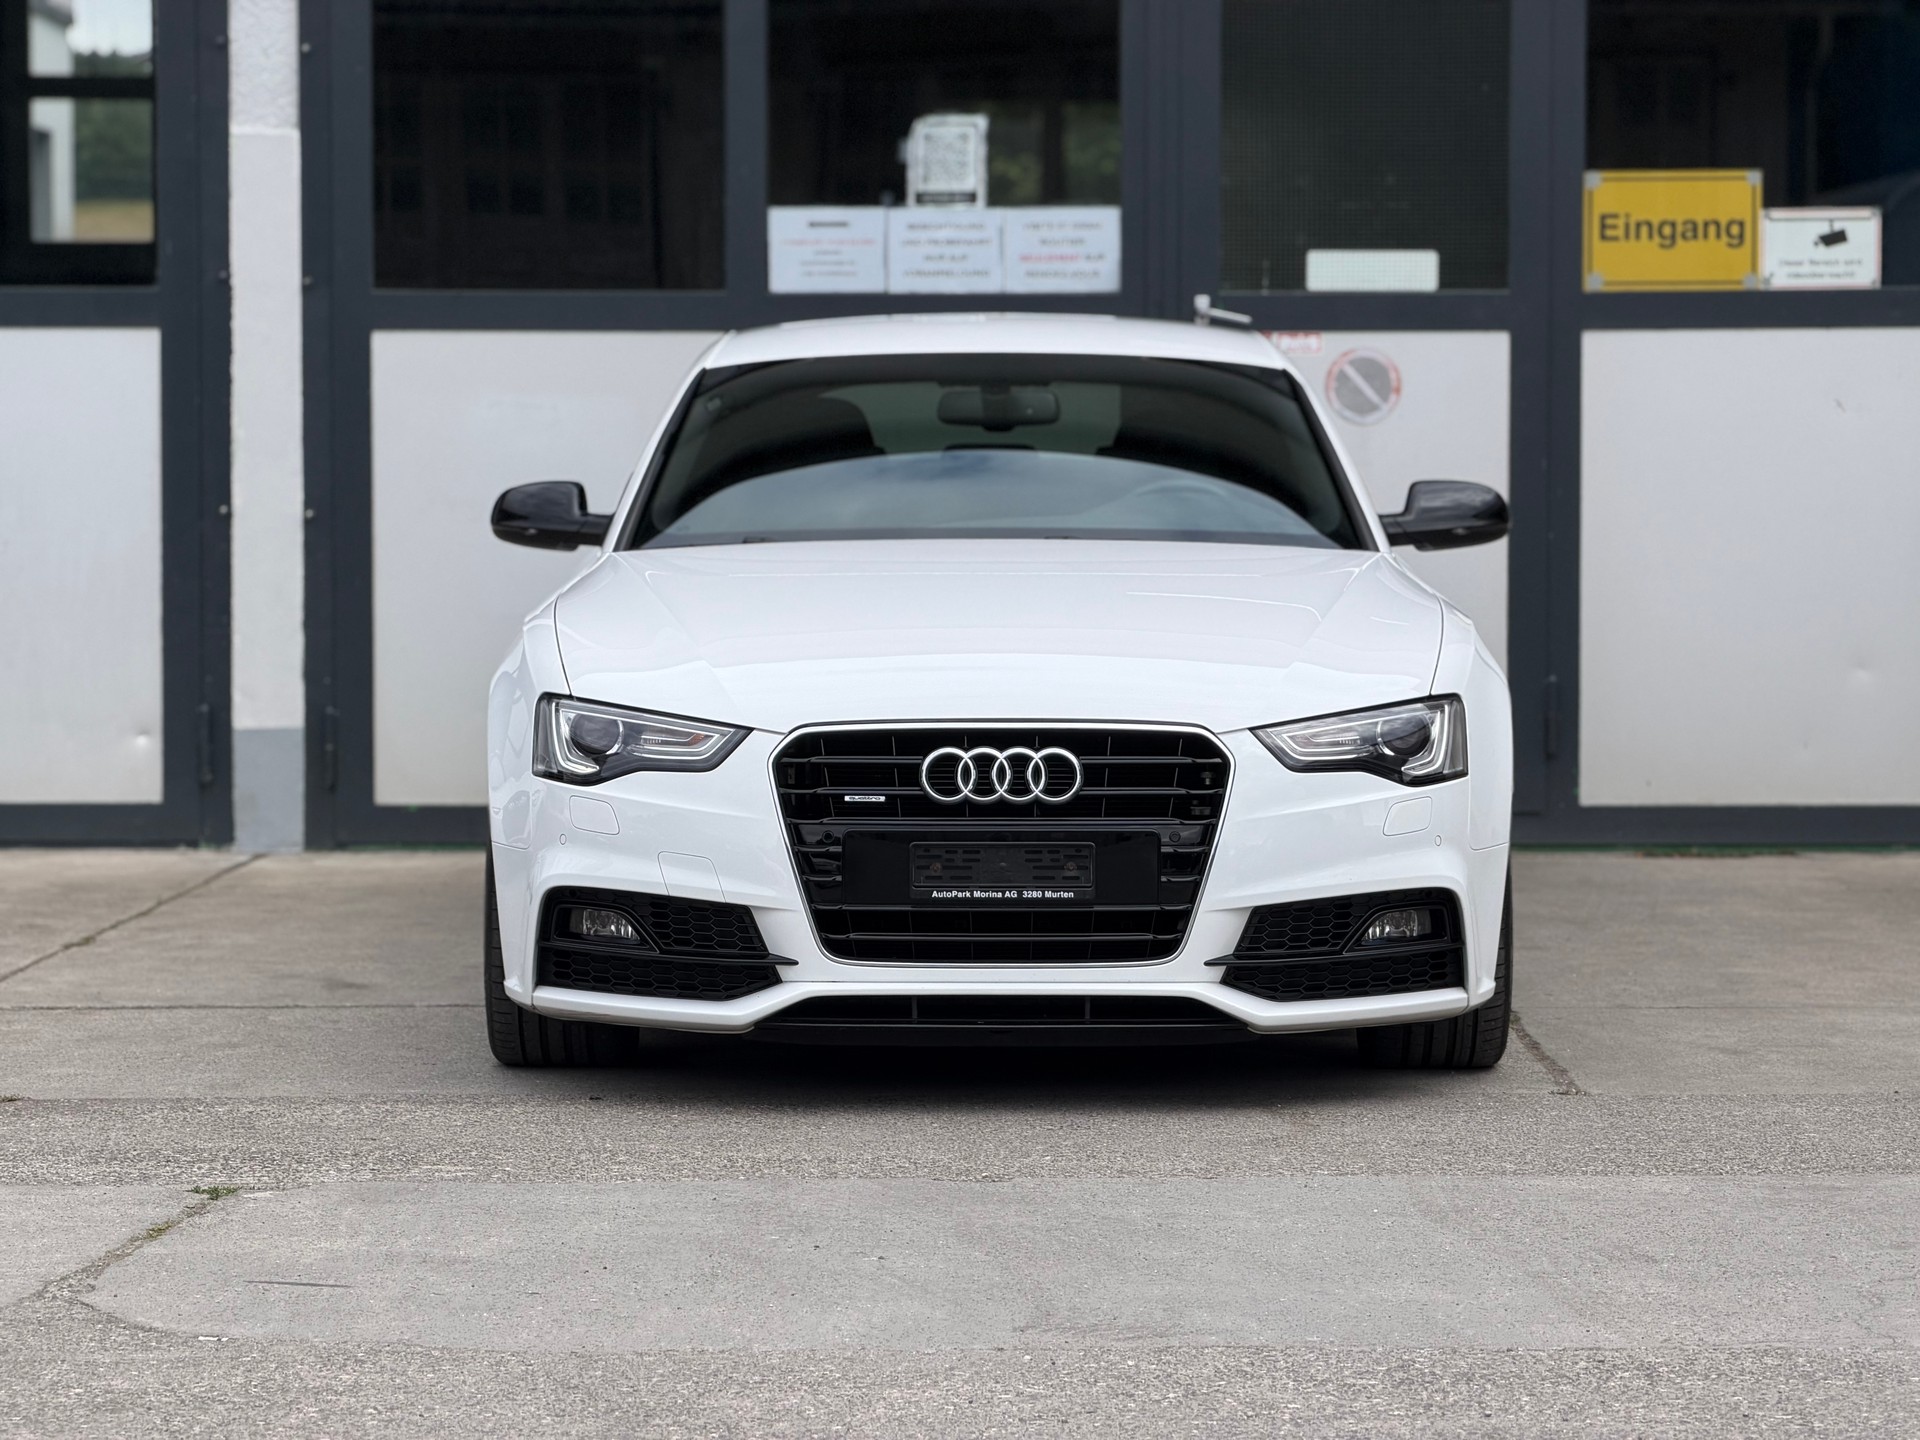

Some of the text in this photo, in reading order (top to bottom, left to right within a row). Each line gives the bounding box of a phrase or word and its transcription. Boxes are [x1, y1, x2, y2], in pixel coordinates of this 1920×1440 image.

[1599, 213, 1746, 250] Eingang
[931, 890, 1074, 898] AutoPark Morina AG 3280 Murten
